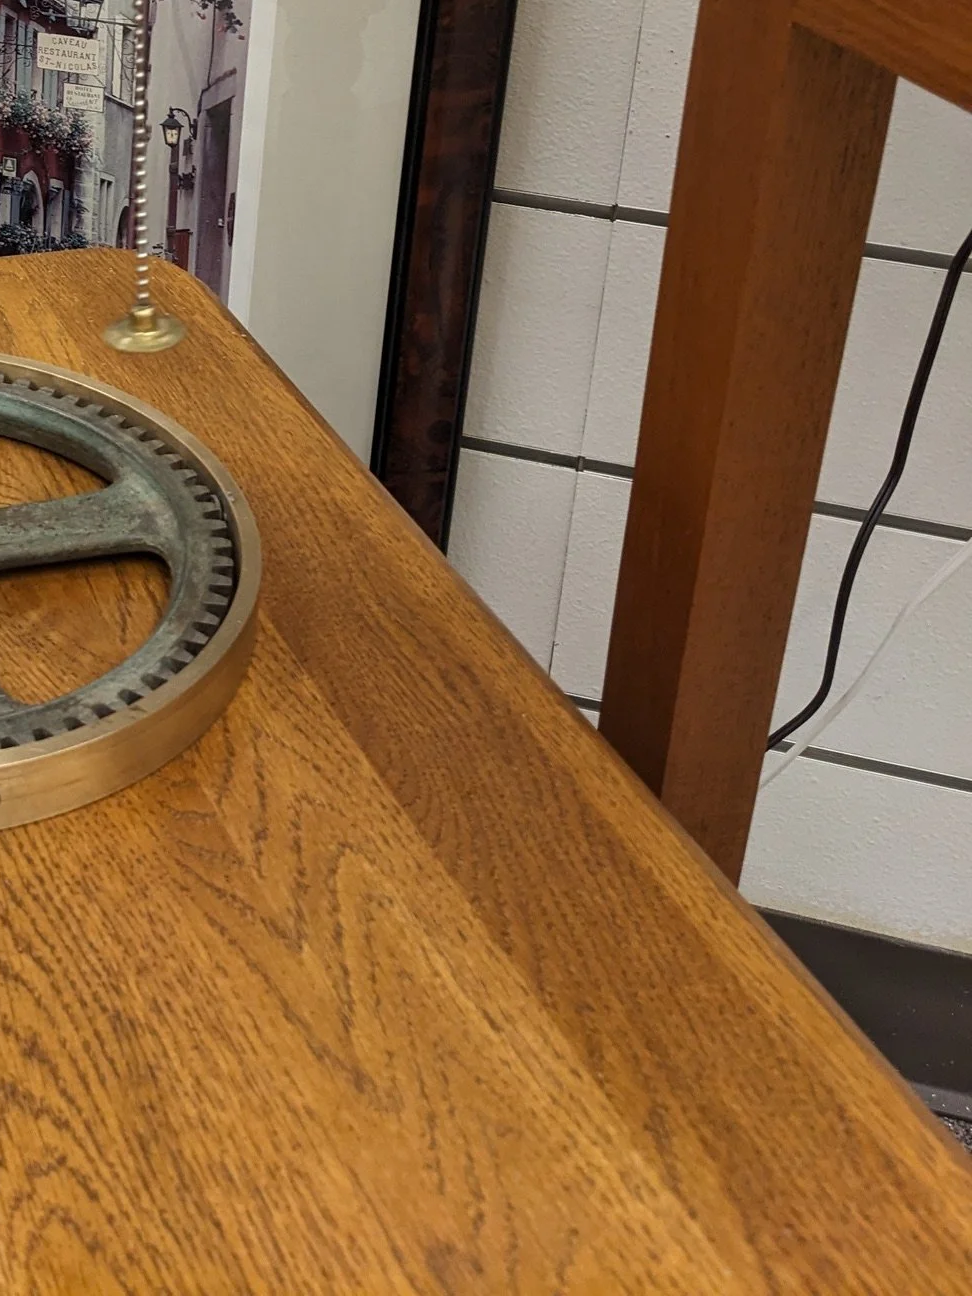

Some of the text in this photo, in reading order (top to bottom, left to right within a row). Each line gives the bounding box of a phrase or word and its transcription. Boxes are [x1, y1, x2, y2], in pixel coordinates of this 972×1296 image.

[52, 37, 87, 49] CAVEAU
[38, 46, 97, 61] RESTAURANT
[39, 55, 97, 71] ST-NICOLAS
